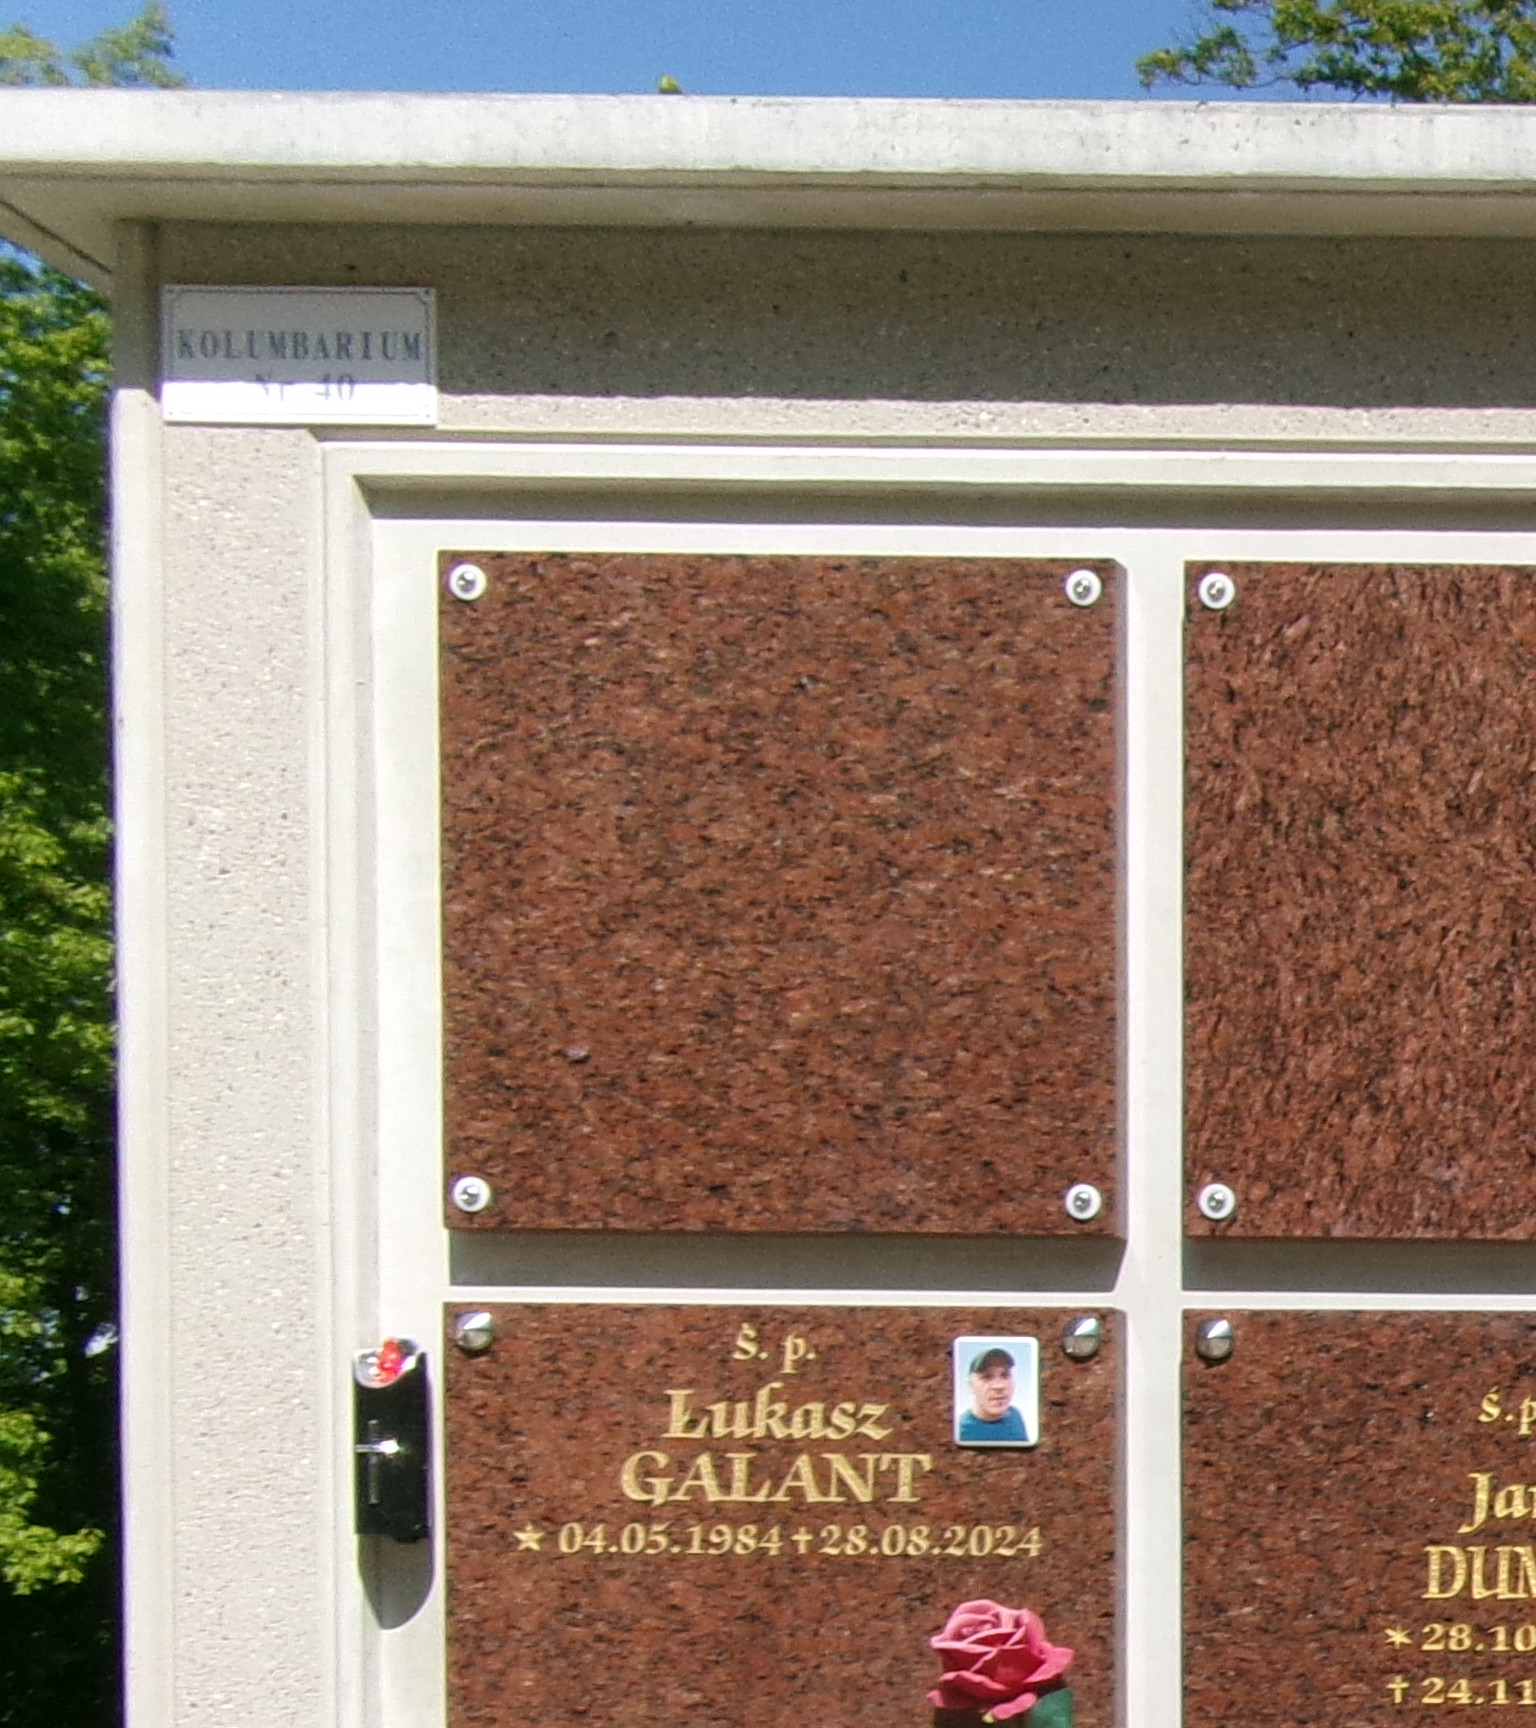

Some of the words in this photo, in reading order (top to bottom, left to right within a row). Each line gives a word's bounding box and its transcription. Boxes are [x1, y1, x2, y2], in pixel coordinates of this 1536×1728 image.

[178, 329, 421, 360] KOLUMBARIUM
[660, 1383, 893, 1441] Łukasz
[621, 1451, 932, 1506] GALANT
